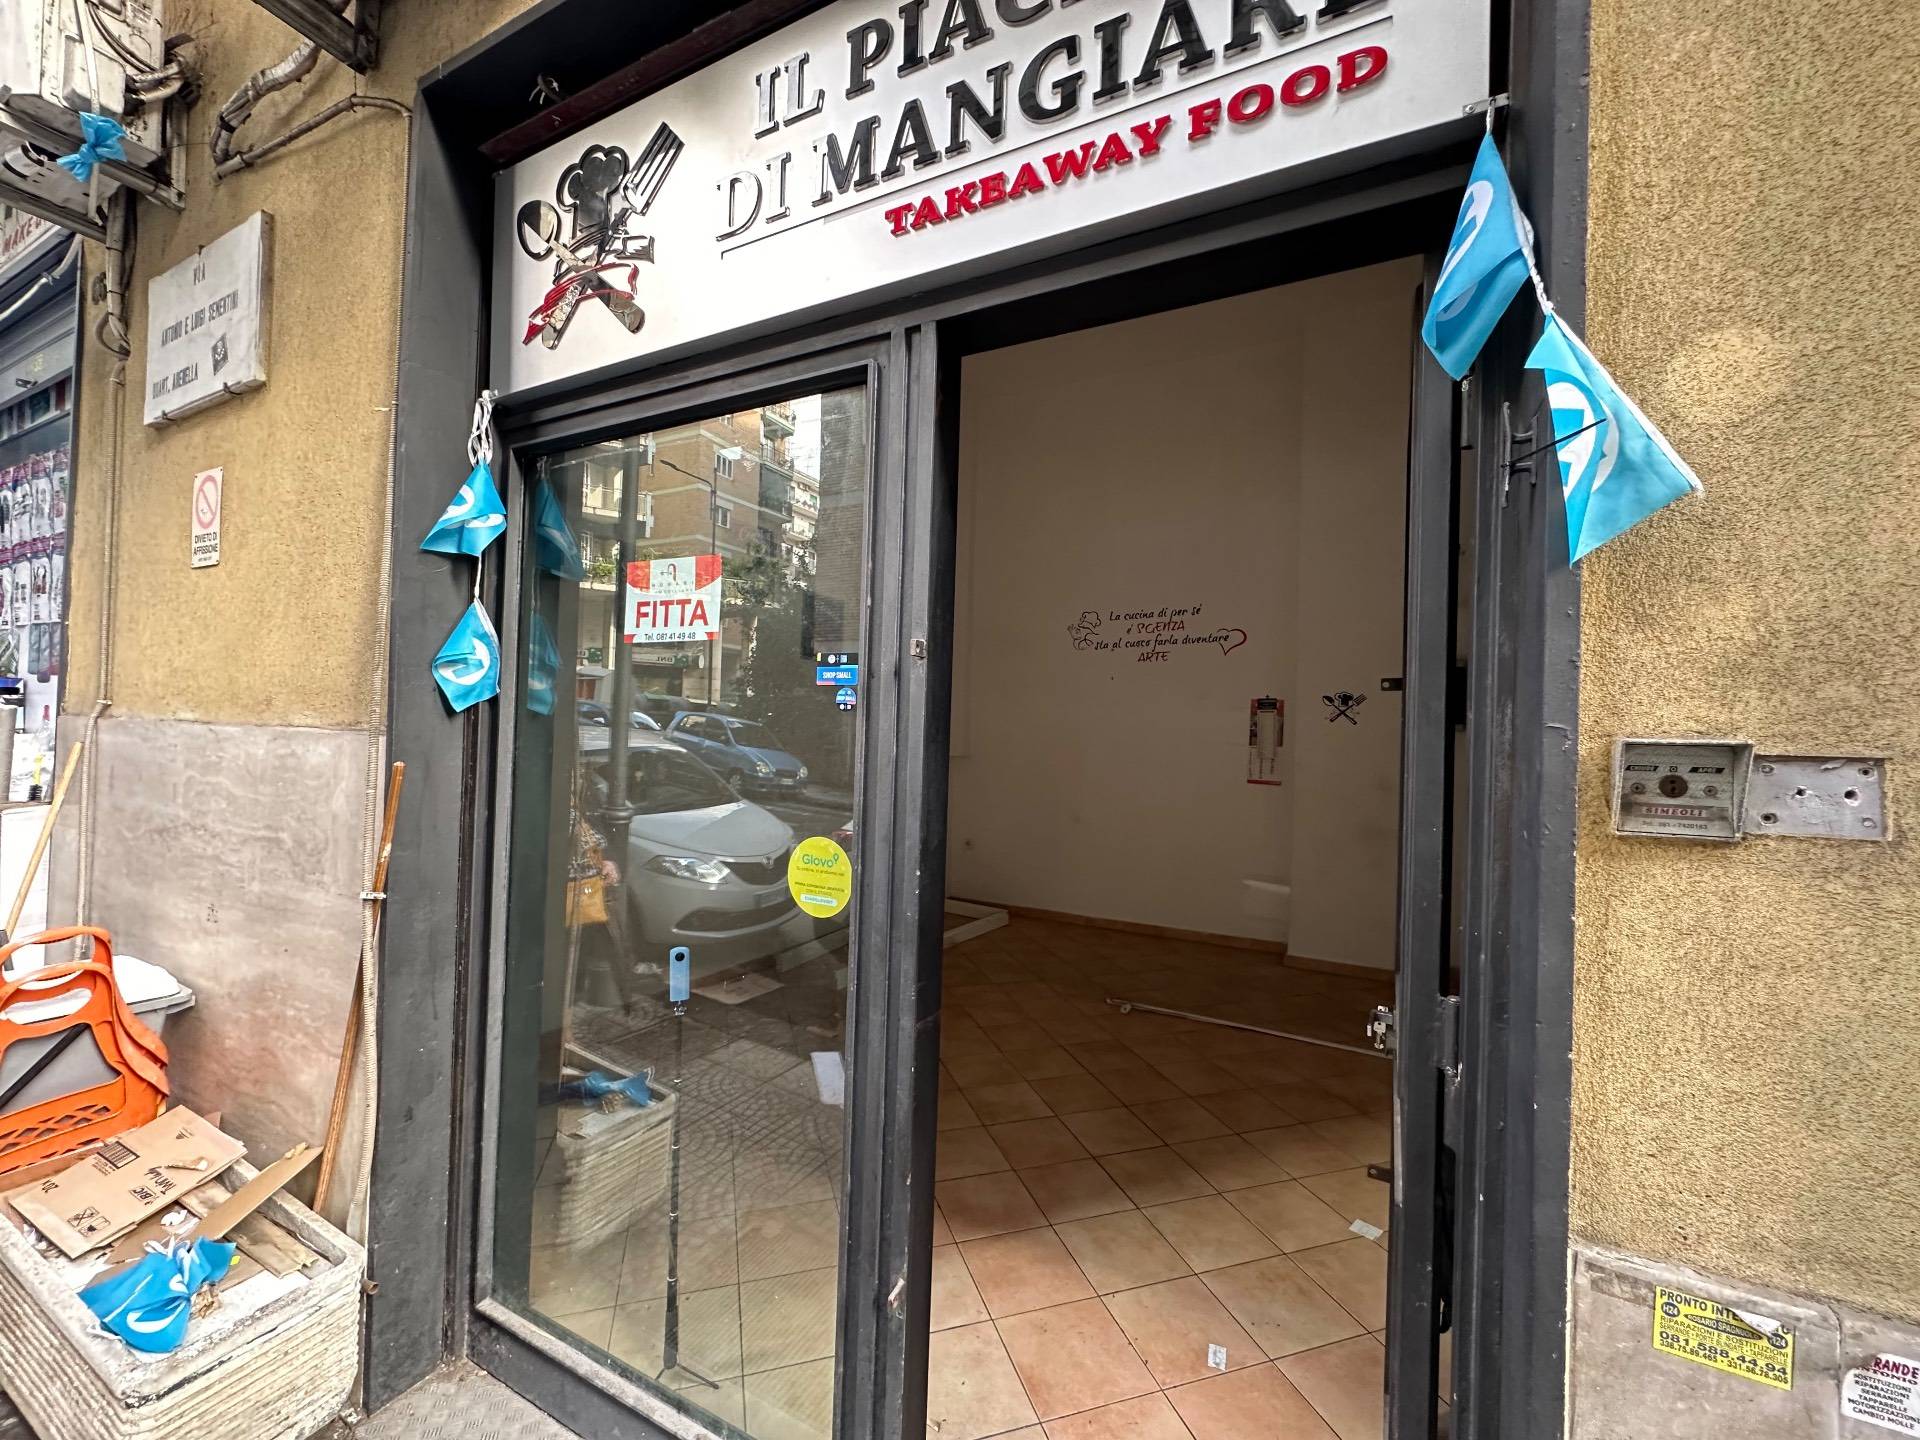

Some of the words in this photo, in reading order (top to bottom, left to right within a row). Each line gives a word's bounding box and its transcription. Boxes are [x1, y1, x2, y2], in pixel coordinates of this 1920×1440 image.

[755, 51, 825, 140] IL
[884, 114, 1172, 238] TAKEAWAY
[1188, 46, 1389, 142] FOOD
[716, 152, 792, 242] DI
[193, 262, 206, 286] VIA
[161, 319, 183, 347] ANTONIO
[184, 316, 190, 336] E
[191, 307, 206, 331] LUIGI
[194, 532, 212, 545] DIVIETO
[212, 531, 218, 542] DI
[193, 543, 219, 556] AFFISSIONE
[636, 598, 709, 628] FITTA
[1109, 611, 1120, 621] La
[1124, 609, 1154, 621] cucina
[1158, 607, 1168, 618] di
[1170, 609, 1188, 624] per
[644, 633, 654, 641] Tel.
[677, 632, 686, 640] 49
[688, 631, 696, 639] 48
[1112, 638, 1121, 649] al
[1125, 639, 1151, 648] cuoco
[1152, 633, 1178, 652] farla
[1182, 634, 1230, 646] diventare
[1137, 651, 1171, 662] ARTE
[1646, 807, 1704, 817] SIMEOLI
[801, 853, 834, 868] Glovo
[133, 1187, 154, 1201] BIC
[1659, 1288, 1708, 1312] PRONTO
[1662, 1303, 1678, 1316] H24
[1660, 1315, 1715, 1337] RIPARAZIONI
[1725, 1335, 1789, 1359] SOSTITUZIONI
[1659, 1330, 1788, 1376] 081.588.44.94
[1853, 1373, 1912, 1394] SOSTITUZIONI
[1854, 1379, 1910, 1400] RIPARAZIONI
[1858, 1393, 1908, 1413] TAPPARELLE
[1860, 1387, 1904, 1405] SERRANDE
[1852, 1406, 1885, 1421] CAMBIO
[1887, 1416, 1915, 1430] MOLLE
